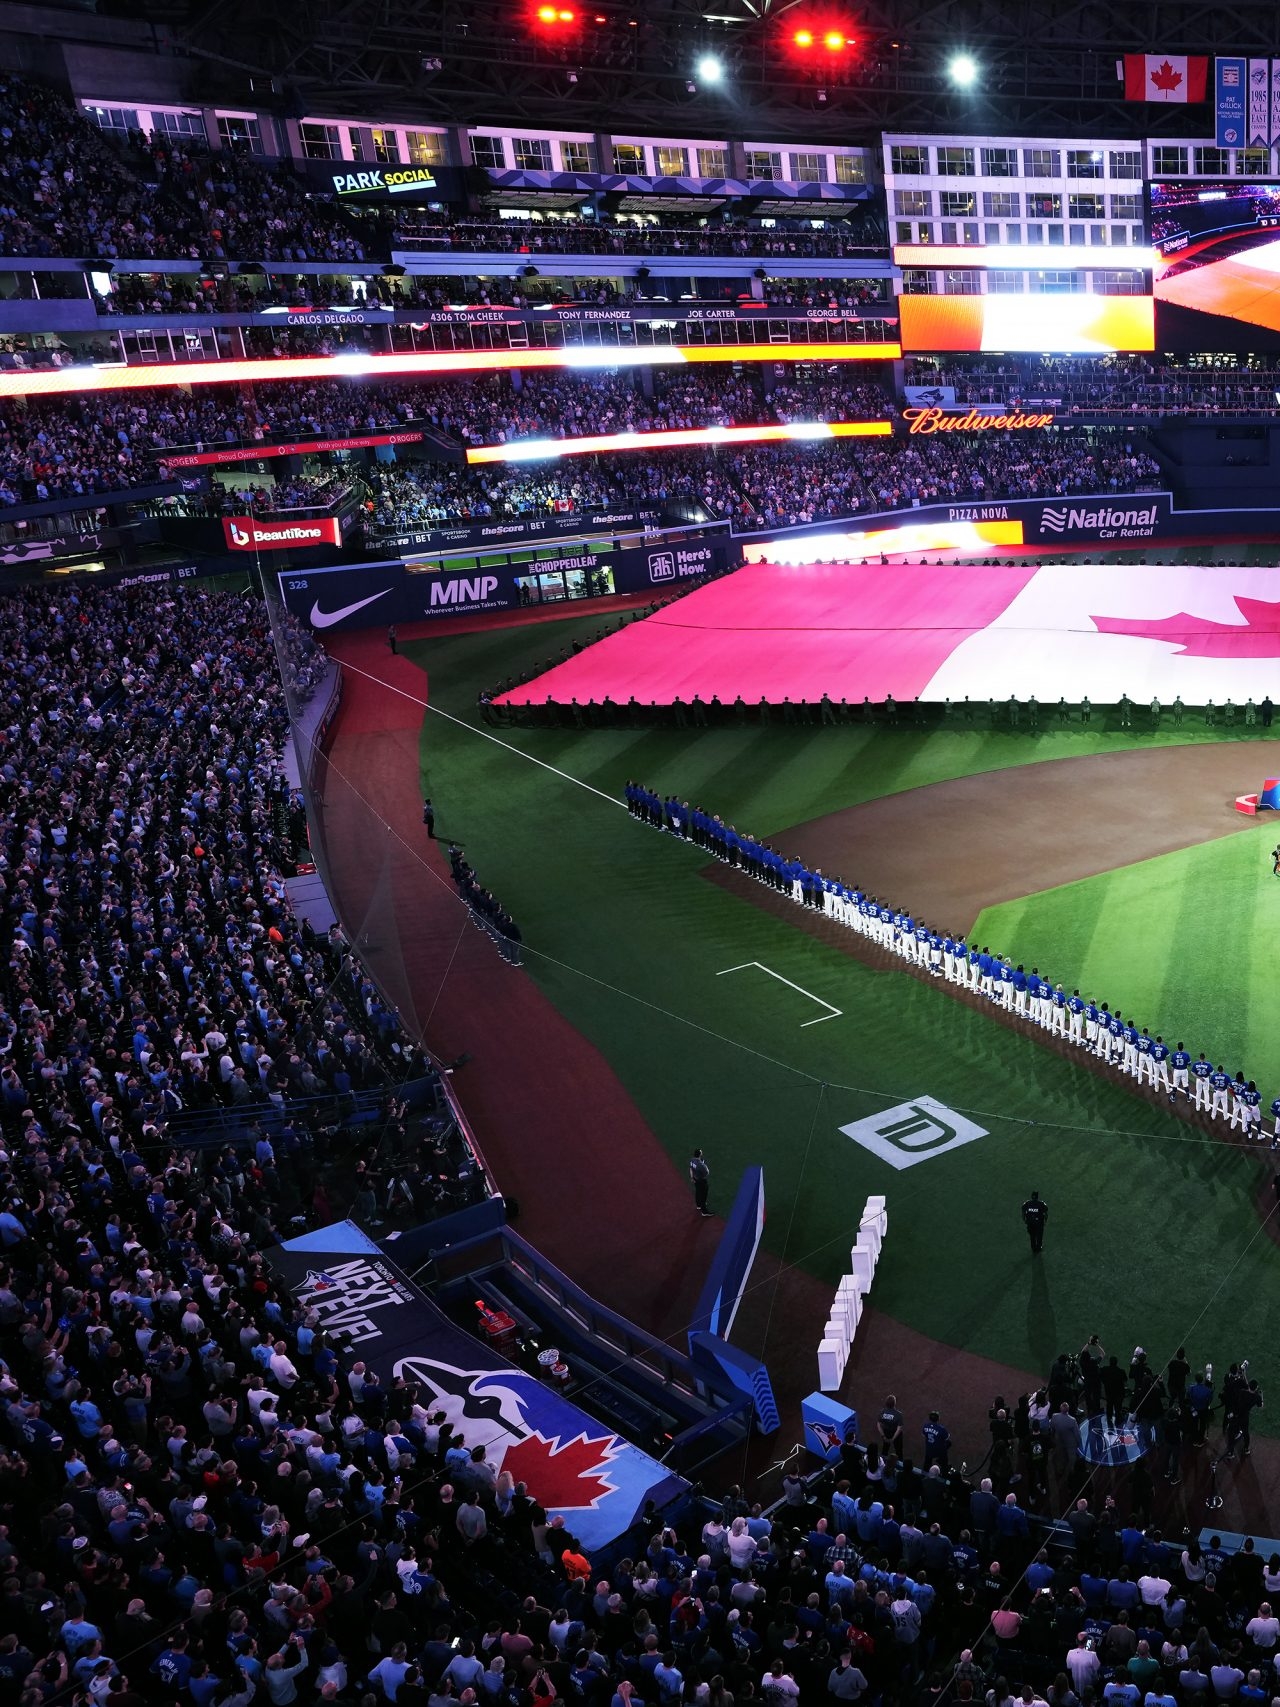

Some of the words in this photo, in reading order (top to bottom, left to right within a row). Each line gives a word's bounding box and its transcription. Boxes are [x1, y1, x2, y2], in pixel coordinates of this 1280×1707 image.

[332, 171, 386, 192] PARK
[385, 169, 434, 185] SOCIAL
[903, 407, 1054, 434] Budweiser
[168, 456, 198, 467] ROGERS
[949, 508, 979, 521] PIZZA
[981, 507, 1008, 520] NOVA
[1067, 505, 1156, 528] National
[253, 527, 321, 542] BeautiTone
[677, 547, 712, 563] Here's
[678, 563, 707, 576] How.
[430, 575, 499, 606] MNP
[874, 1105, 957, 1153] TD
[373, 1261, 394, 1281] TORONTO
[324, 1259, 405, 1311] NEXT
